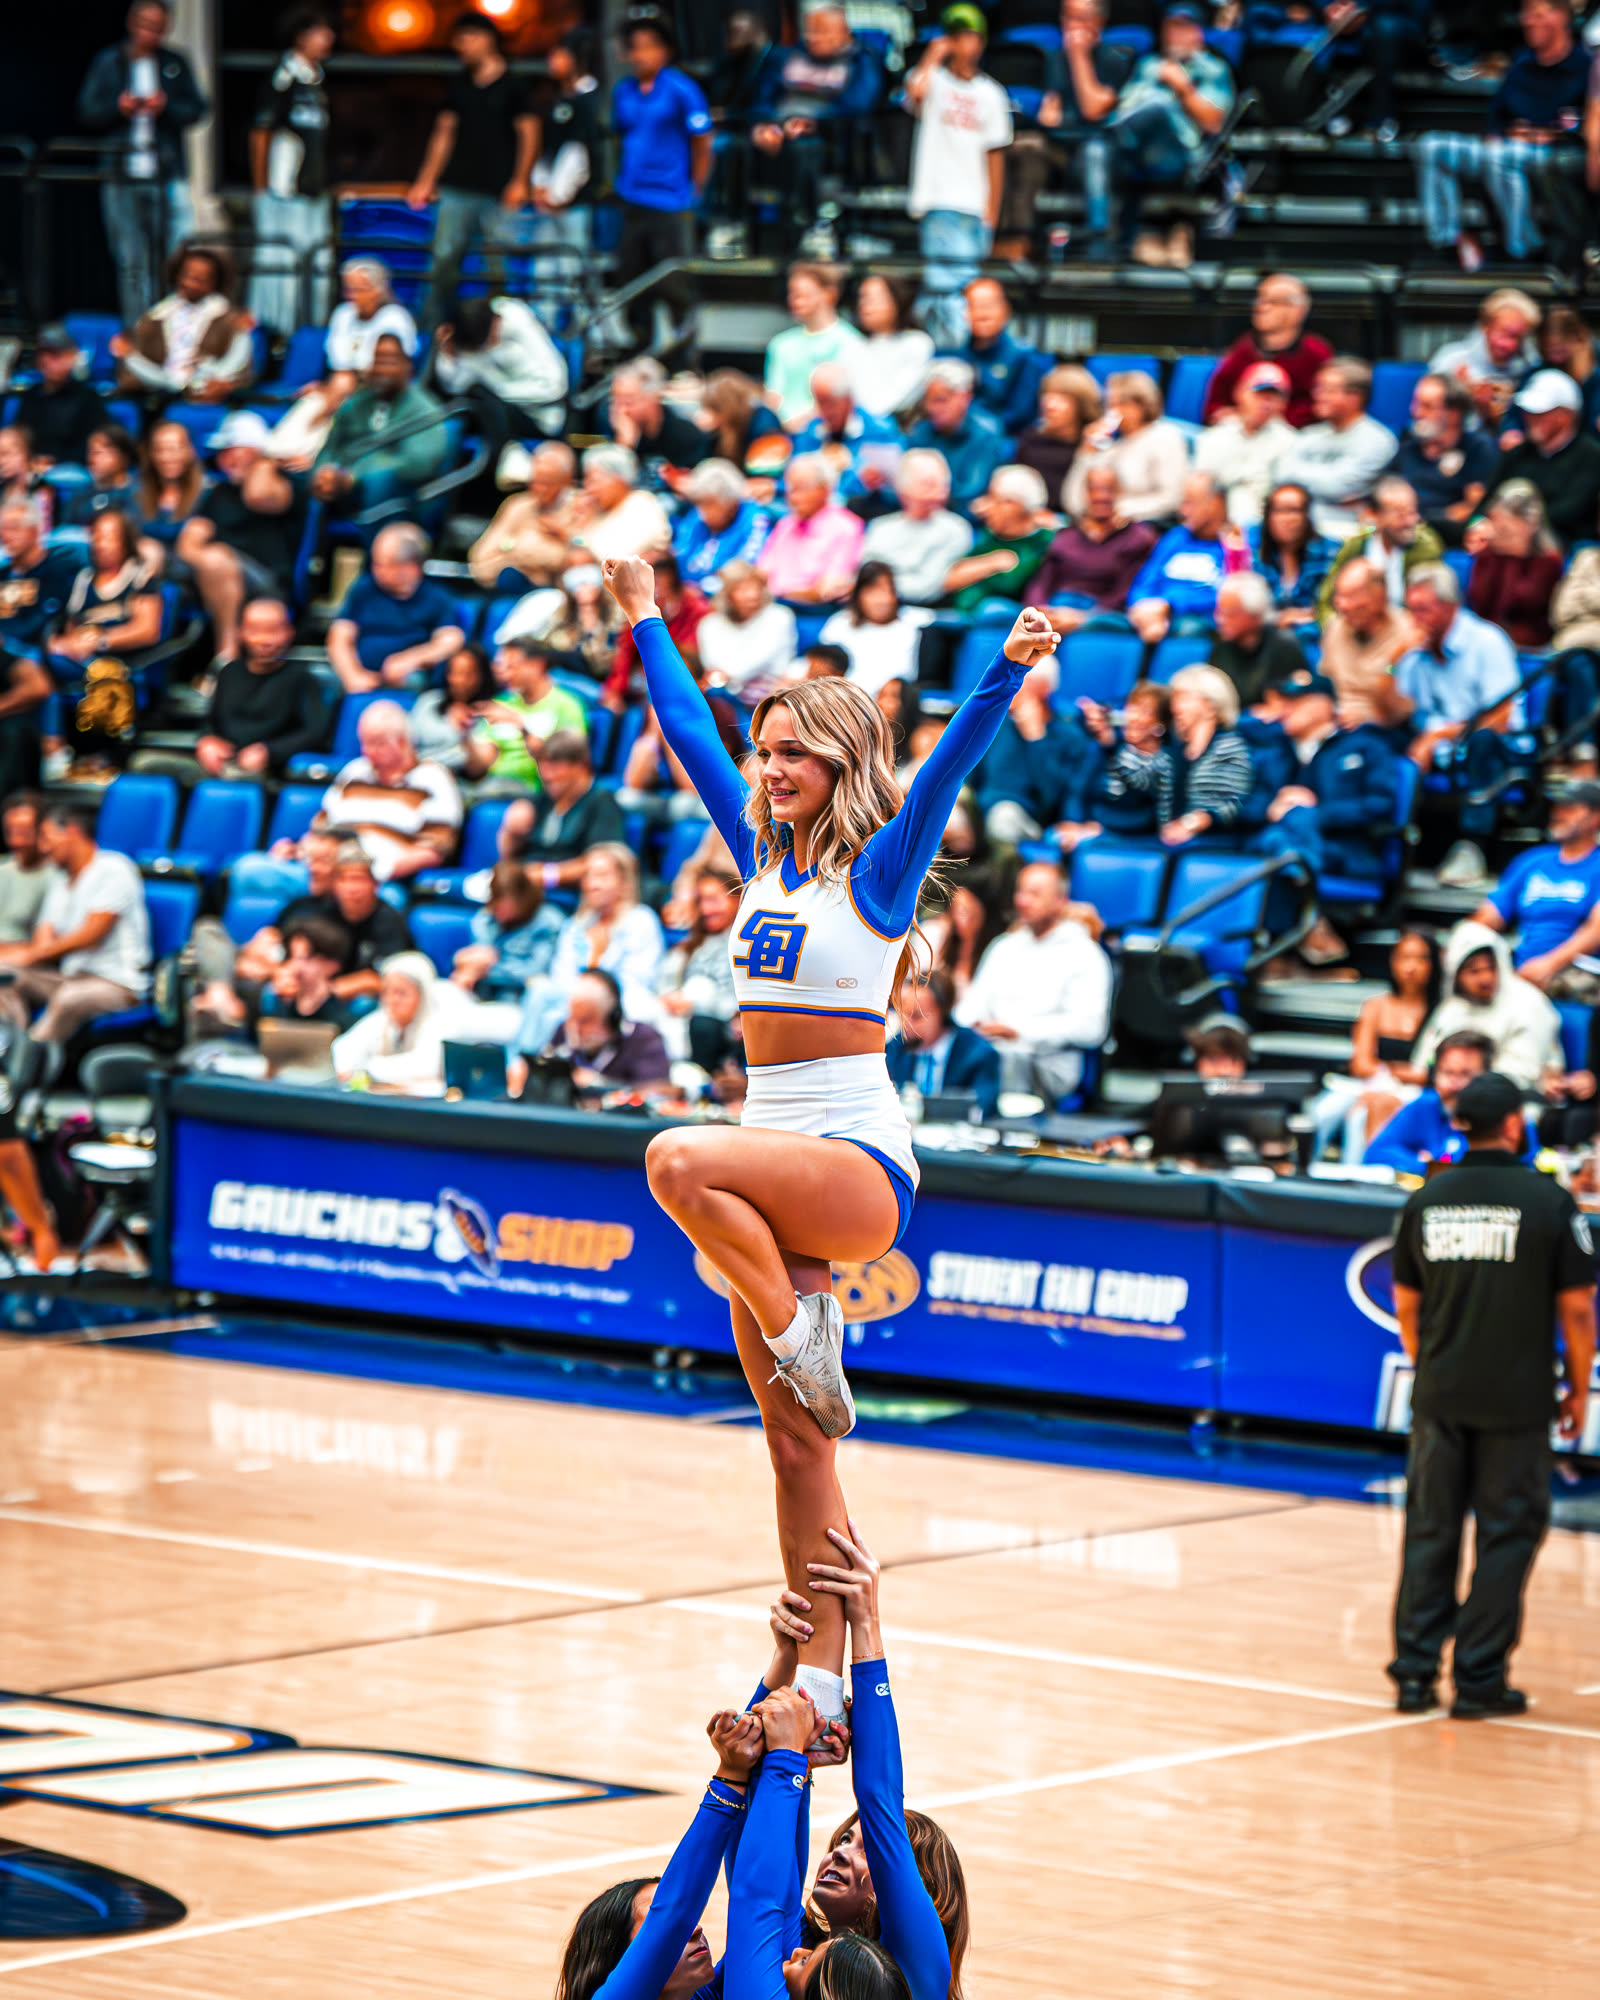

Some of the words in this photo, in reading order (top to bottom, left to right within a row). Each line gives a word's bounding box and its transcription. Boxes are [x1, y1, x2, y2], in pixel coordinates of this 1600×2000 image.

[209, 1180, 434, 1252] GAUCHOS
[497, 1211, 634, 1271] SHOP
[1422, 1223, 1519, 1262] SECURITY
[927, 1251, 1041, 1308] STUDENT
[1041, 1262, 1095, 1315] FAN
[1094, 1268, 1189, 1323] GROUP
